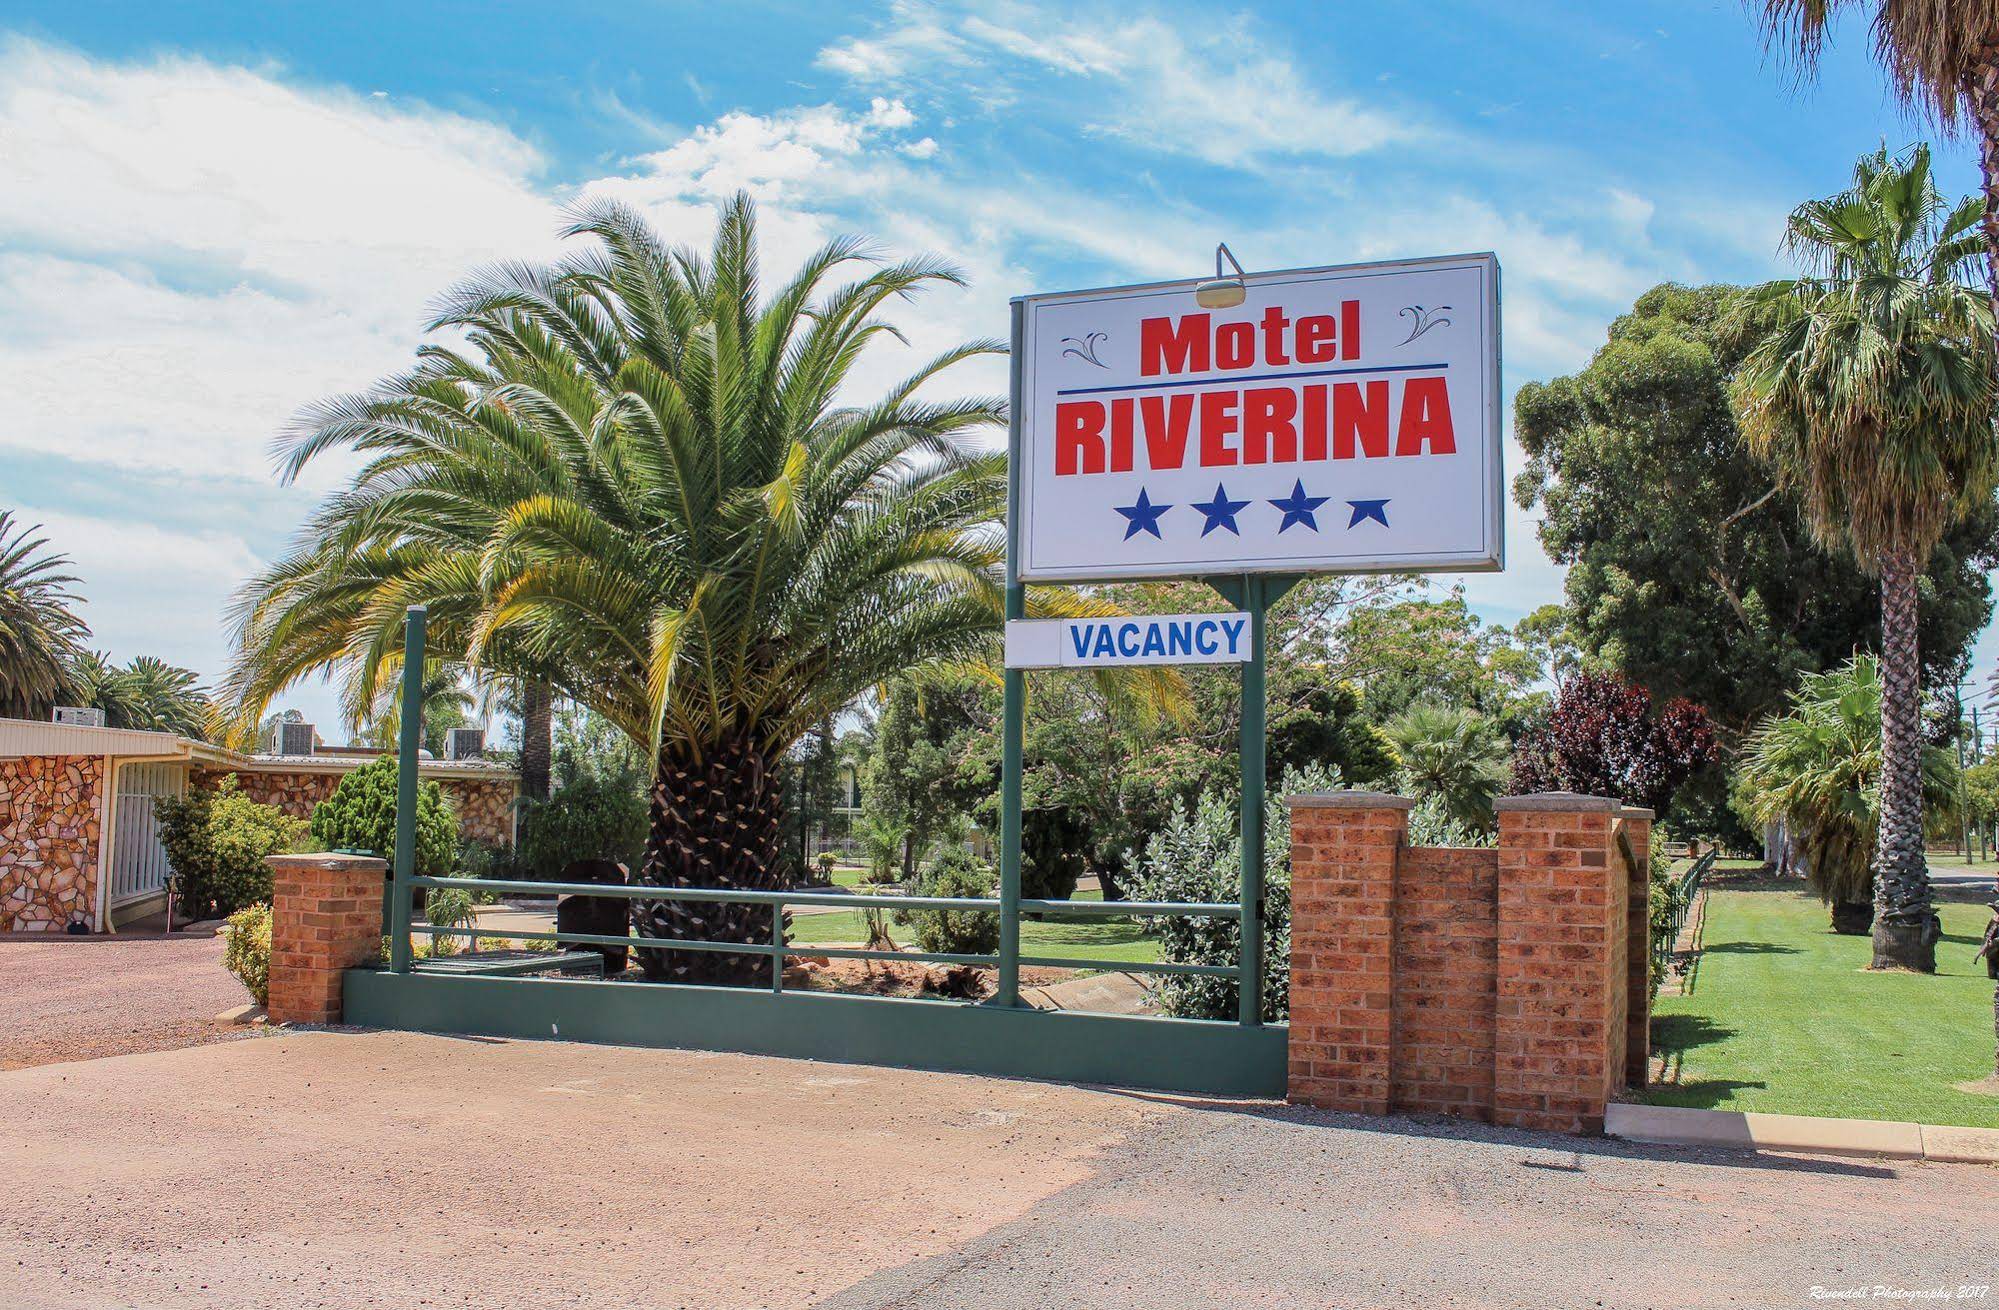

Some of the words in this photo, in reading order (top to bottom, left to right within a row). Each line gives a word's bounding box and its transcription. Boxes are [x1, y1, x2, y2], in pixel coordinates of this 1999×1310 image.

[1140, 300, 1360, 377] Motel
[1055, 376, 1457, 476] RIVERINA
[1070, 619, 1246, 659] VACANCY
